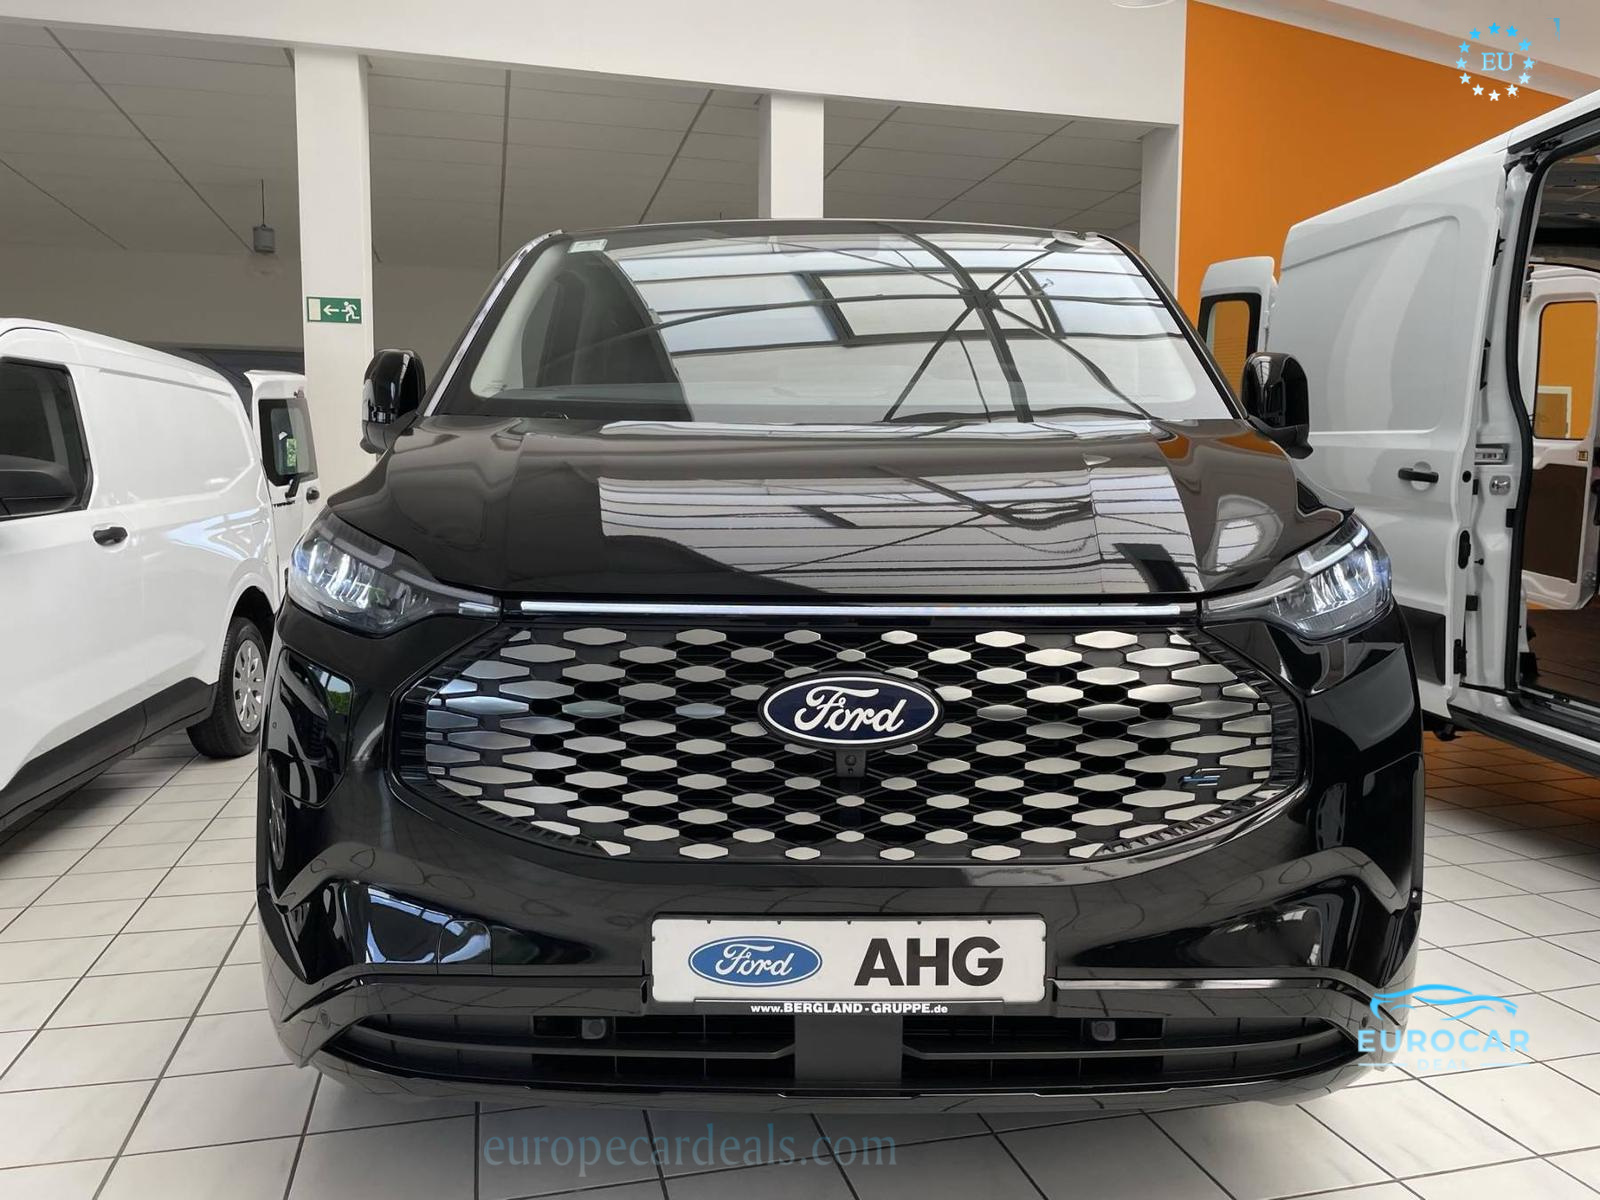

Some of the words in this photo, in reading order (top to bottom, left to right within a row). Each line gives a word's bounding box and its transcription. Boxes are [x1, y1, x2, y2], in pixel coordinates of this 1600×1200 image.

[794, 686, 908, 732] Ford
[715, 943, 795, 976] Ford
[854, 936, 1004, 987] AHG
